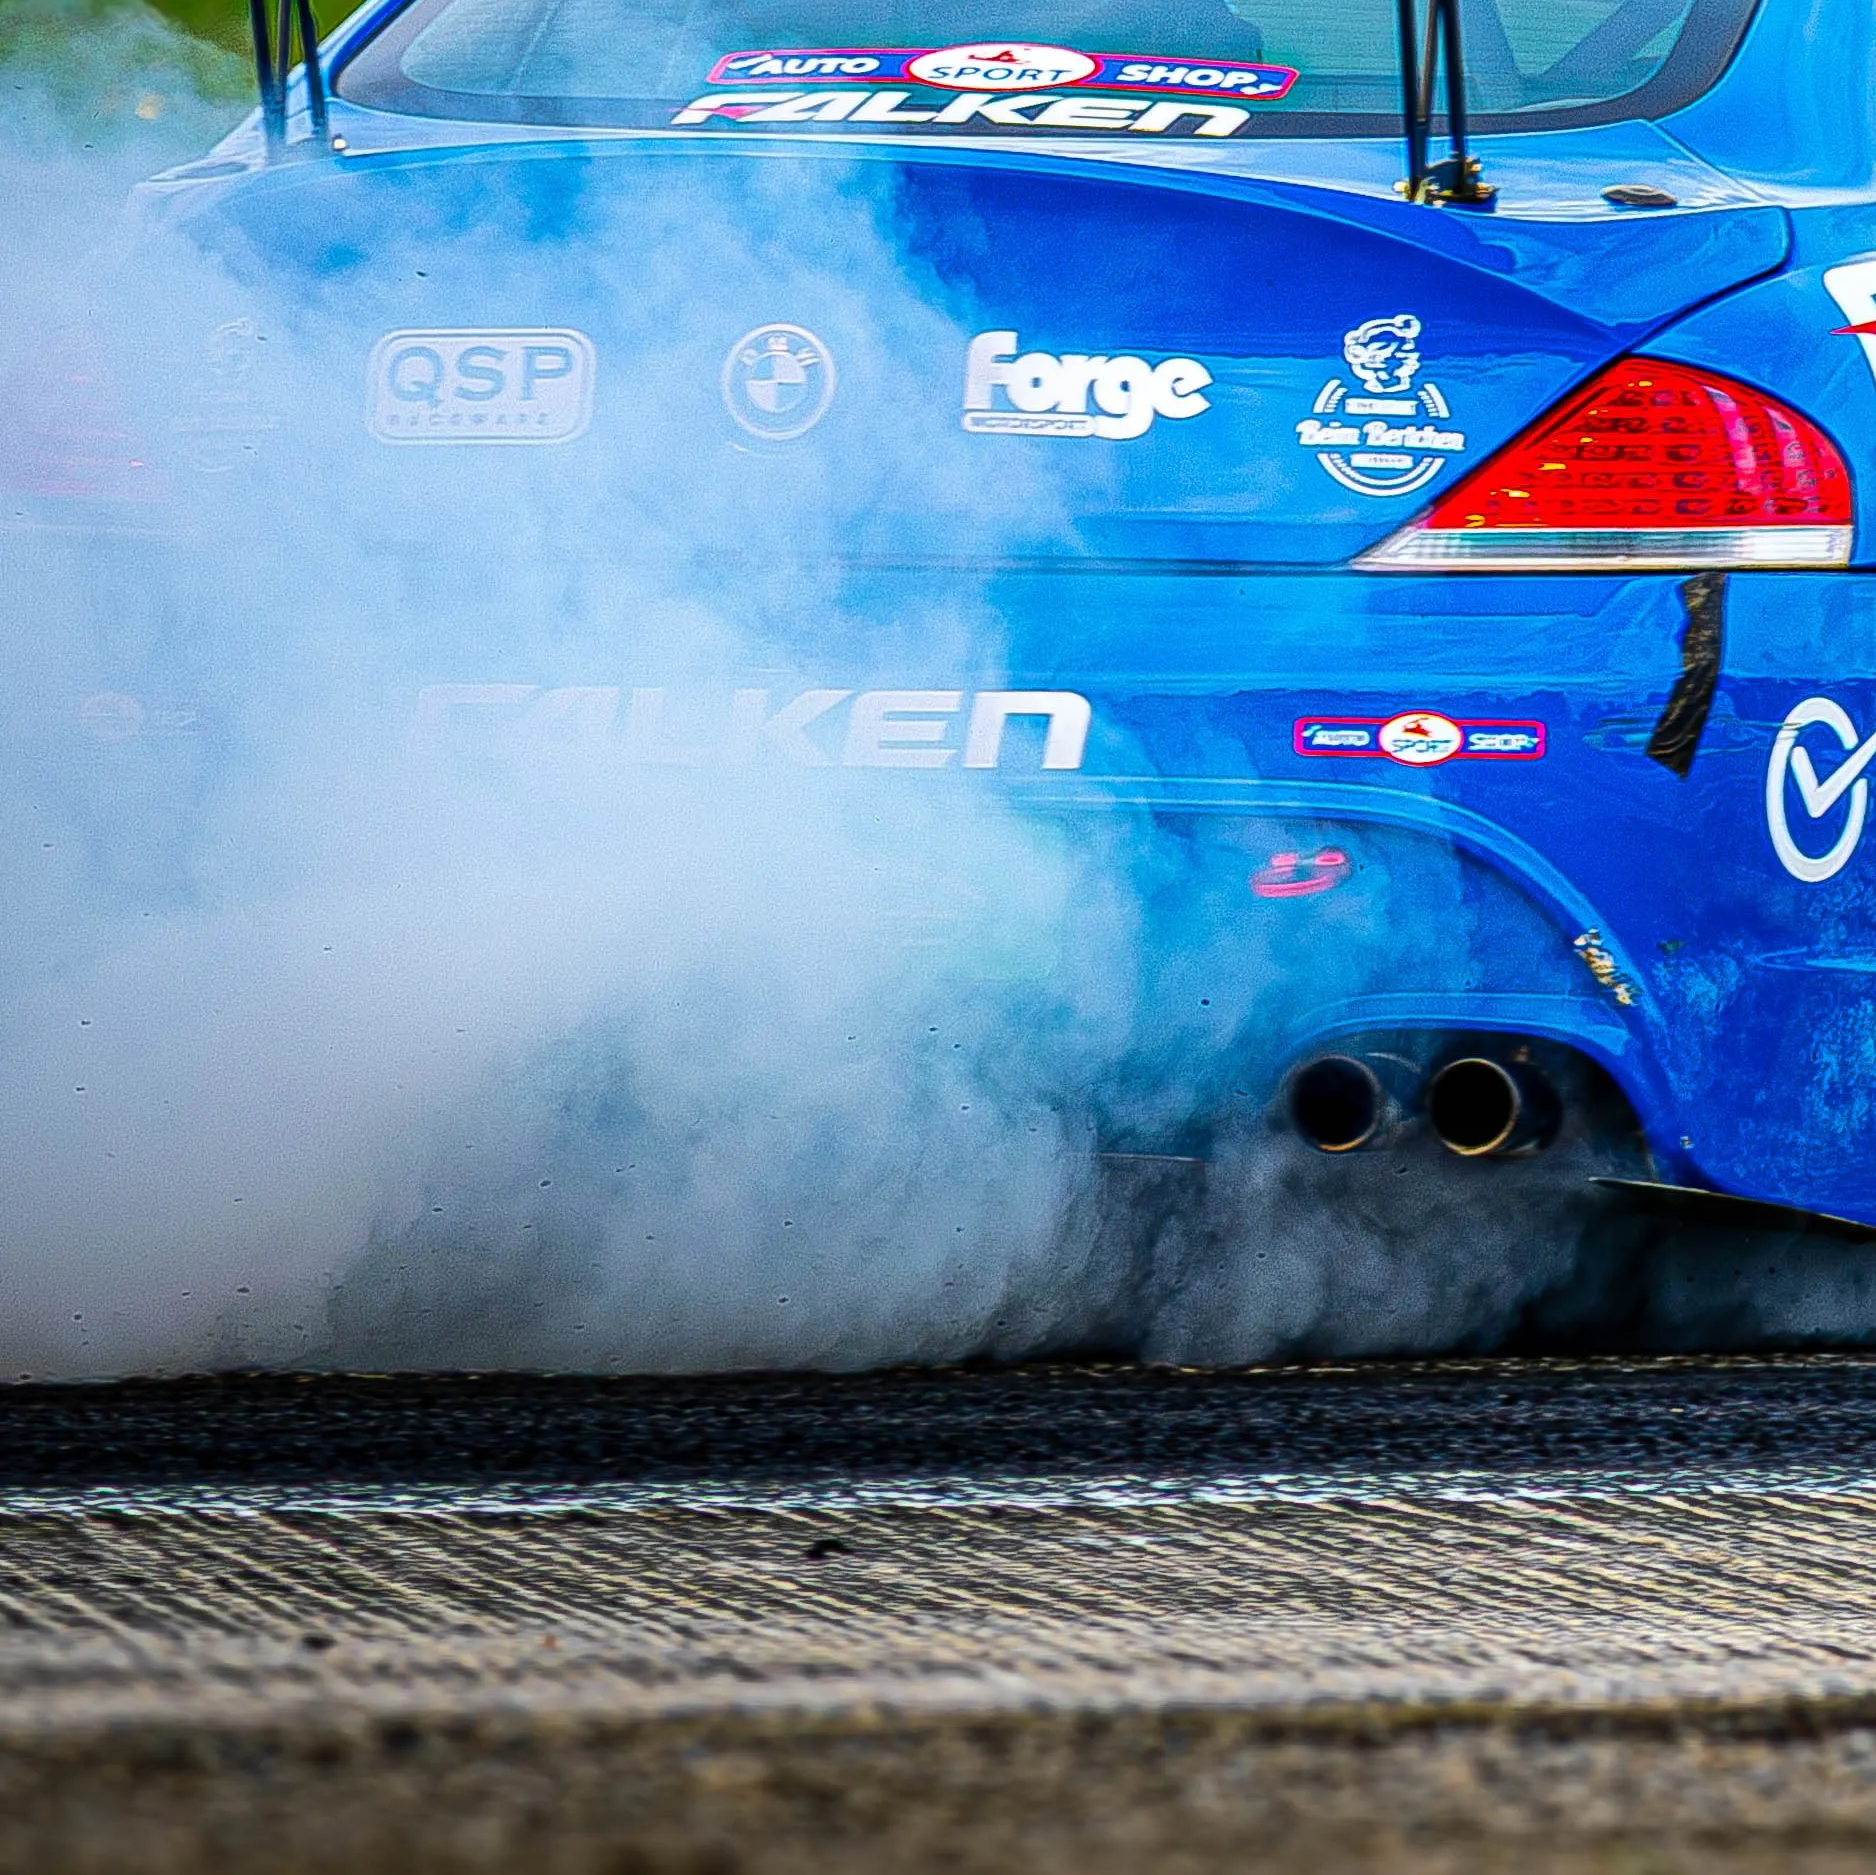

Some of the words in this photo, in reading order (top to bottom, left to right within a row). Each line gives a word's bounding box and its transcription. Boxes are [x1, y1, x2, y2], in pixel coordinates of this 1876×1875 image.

[752, 56, 880, 76] AUTO
[927, 64, 1070, 84] SPORT
[1119, 63, 1257, 89] SHOP
[670, 91, 1252, 137] FALKEN
[389, 344, 573, 409] QSP
